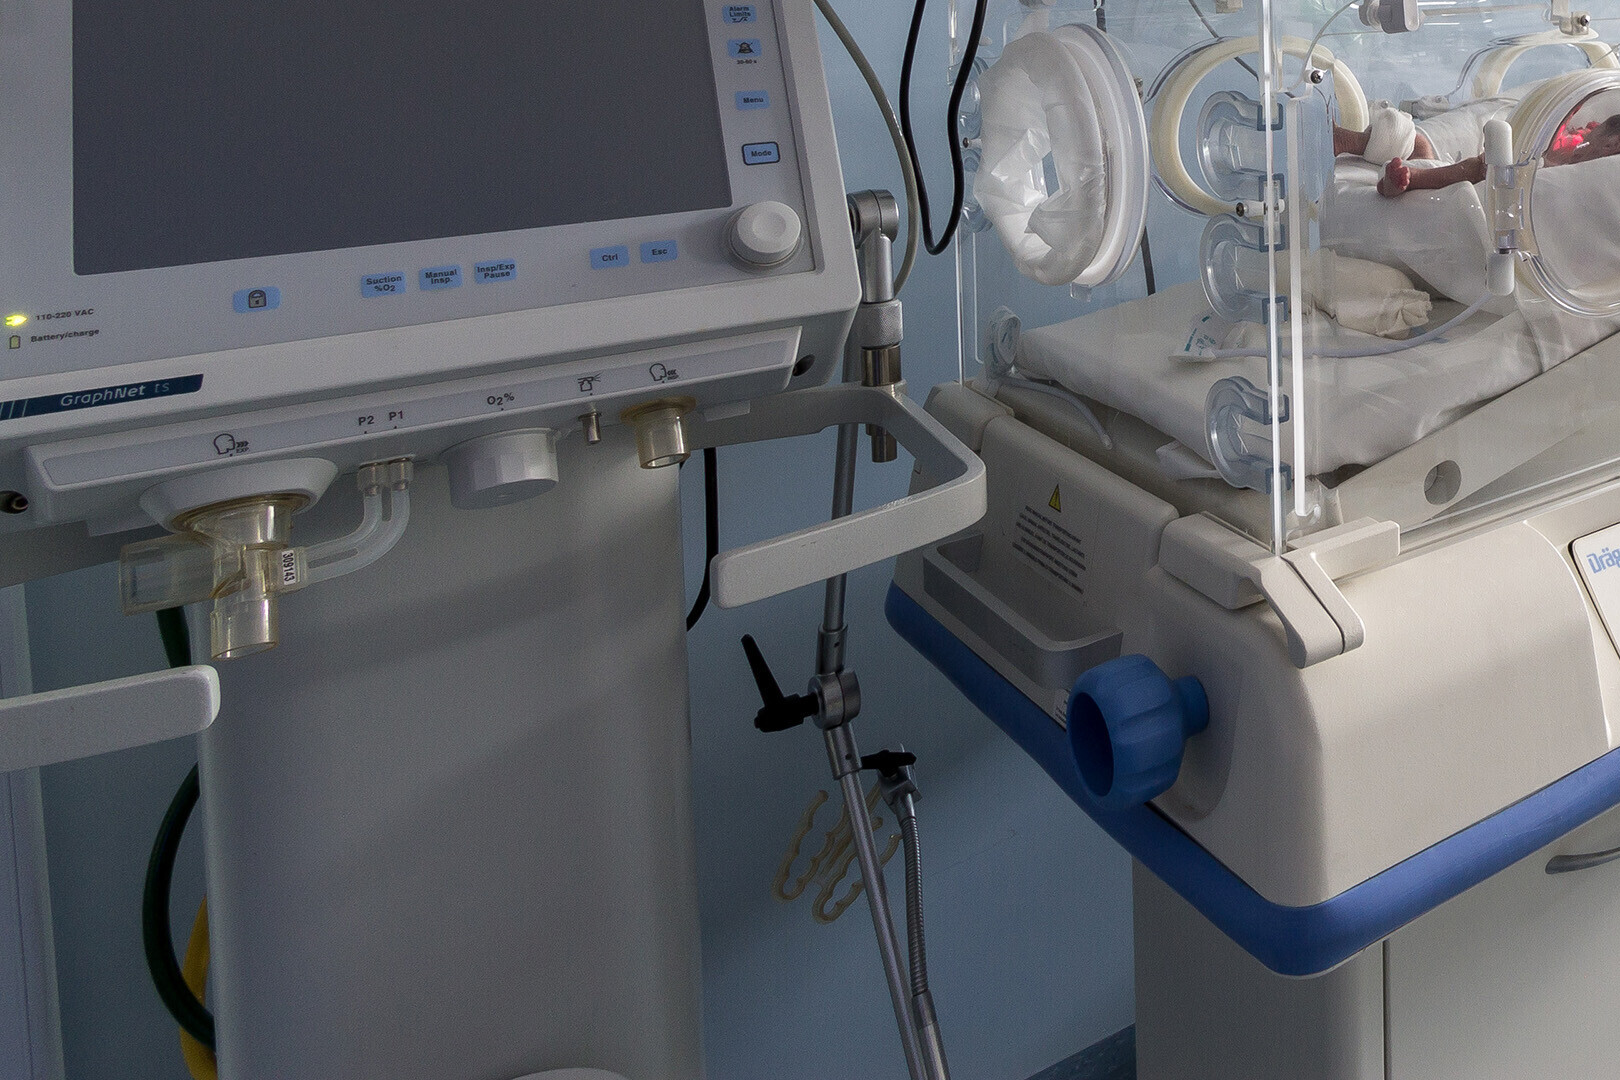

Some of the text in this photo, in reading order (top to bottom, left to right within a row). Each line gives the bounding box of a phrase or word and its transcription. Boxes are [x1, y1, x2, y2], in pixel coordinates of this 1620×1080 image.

[602, 253, 618, 262] Ctrl
[652, 248, 668, 256] Esc
[477, 262, 515, 274] Insp/Exp
[425, 269, 458, 279] Manual
[483, 271, 511, 280] Pause
[366, 275, 402, 286] Suction
[35, 308, 95, 321] 110-220 VAC
[30, 329, 100, 343] Battery/charge
[60, 382, 170, 408] GraphNet ts
[358, 415, 375, 426] P2
[389, 410, 404, 421] P1
[282, 552, 295, 582] 309143
